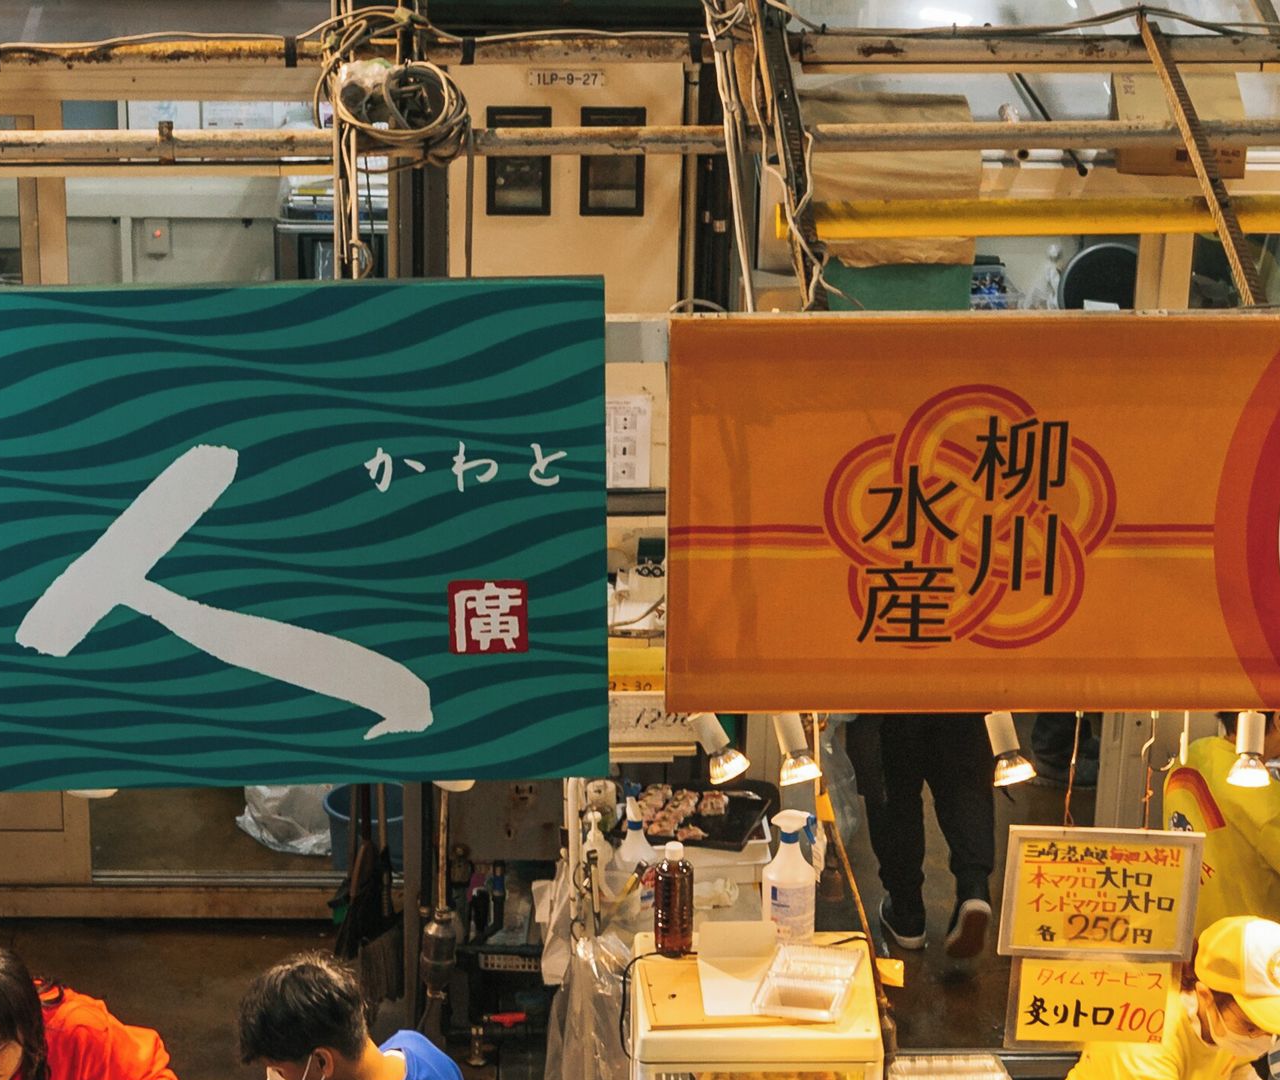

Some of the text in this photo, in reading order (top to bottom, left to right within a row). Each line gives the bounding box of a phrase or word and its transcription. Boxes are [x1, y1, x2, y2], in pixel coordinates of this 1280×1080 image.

[365, 441, 567, 493] かわと
[968, 415, 1071, 597] 柳川
[856, 465, 960, 645] 水産
[1027, 865, 1153, 889] 本マグロ大トロ
[1027, 889, 1175, 914] インドマグロ大トロ
